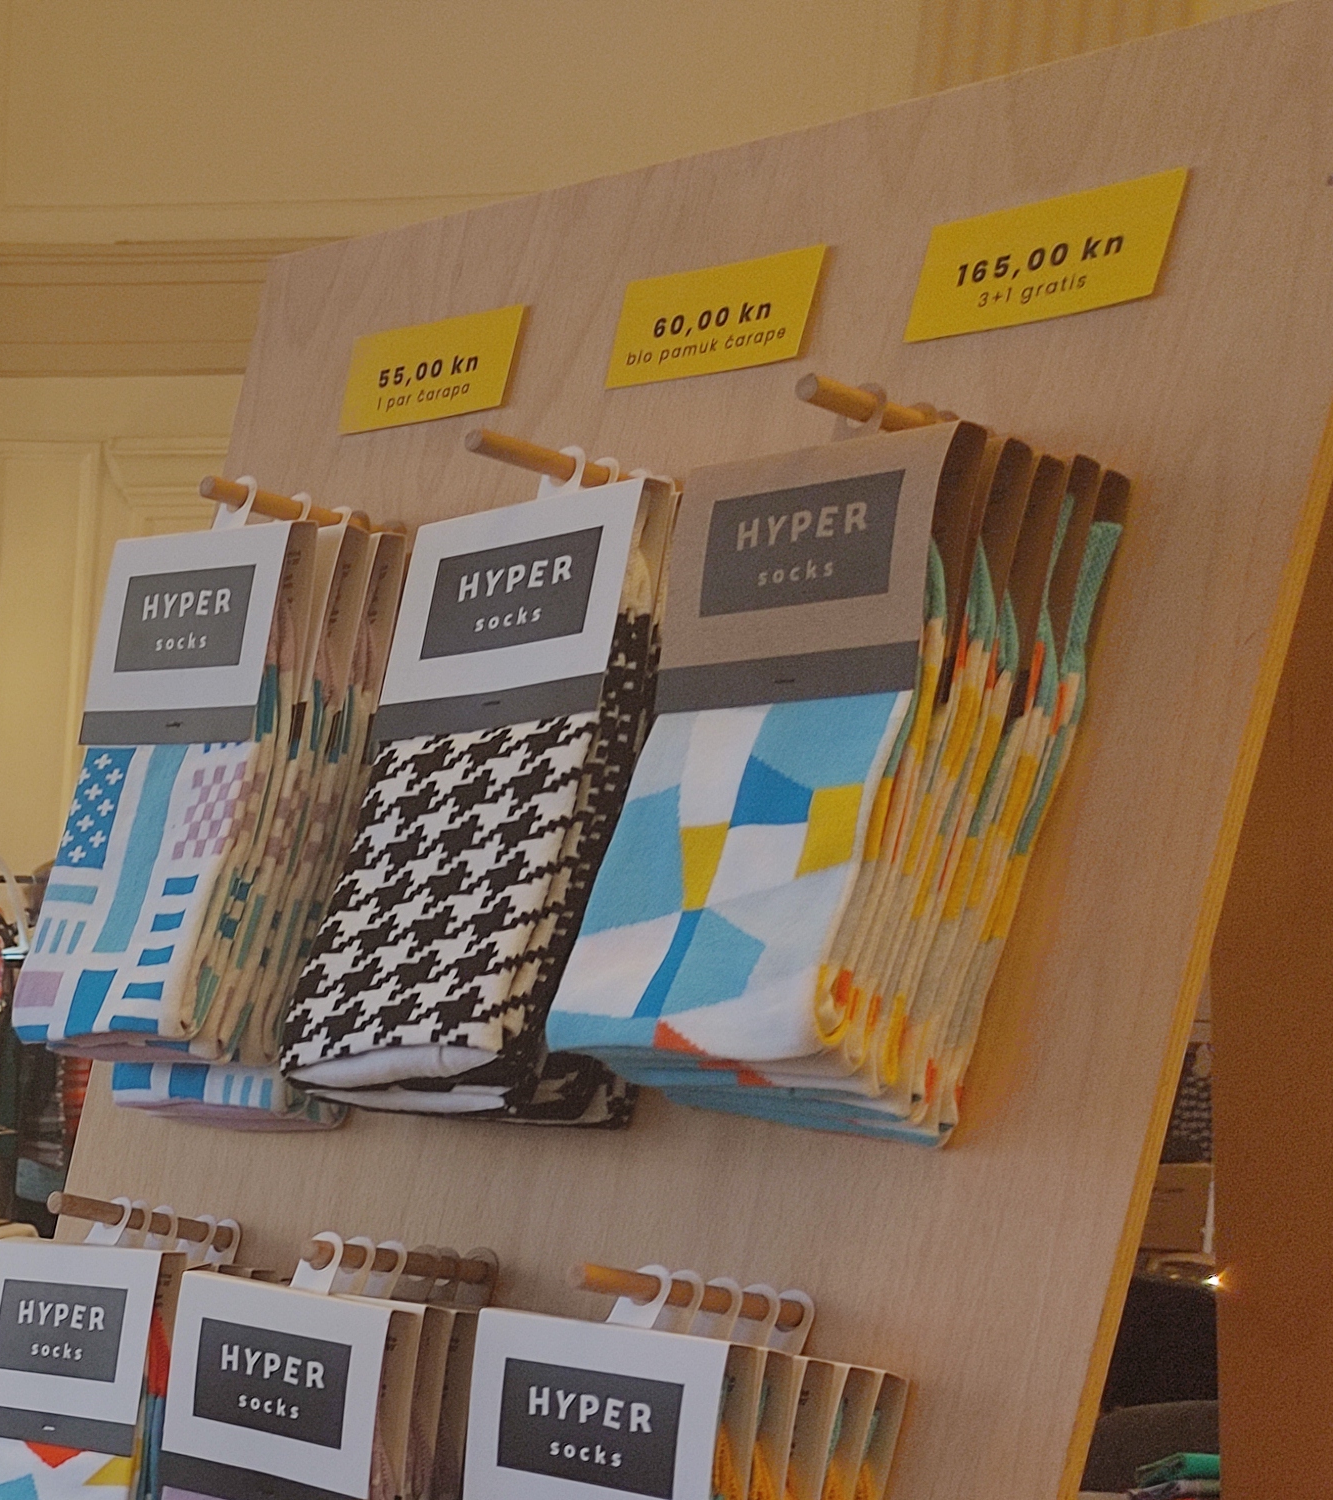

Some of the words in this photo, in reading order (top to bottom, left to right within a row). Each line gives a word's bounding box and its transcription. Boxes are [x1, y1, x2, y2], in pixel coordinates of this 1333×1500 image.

[956, 242, 1069, 287] 165,00
[1081, 235, 1125, 262] kn
[978, 291, 1012, 308] 3+1
[1021, 274, 1088, 304] gratis
[653, 306, 729, 338] 60,00
[738, 302, 771, 324] kn
[659, 338, 718, 365] pamuk
[378, 359, 443, 388] 55,00
[451, 354, 479, 376] kn
[386, 394, 412, 412] par
[736, 501, 868, 551] HYPER
[457, 554, 573, 603] HYPER
[757, 559, 834, 587] socks
[141, 587, 232, 622] HYPER
[473, 606, 543, 633] socks
[155, 632, 208, 652] socks
[17, 1299, 106, 1331] HYPER
[31, 1342, 83, 1361] socks
[220, 1344, 326, 1390] HYPER
[238, 1394, 300, 1419] socks
[528, 1385, 652, 1434] HYPER
[549, 1441, 623, 1468] socks
